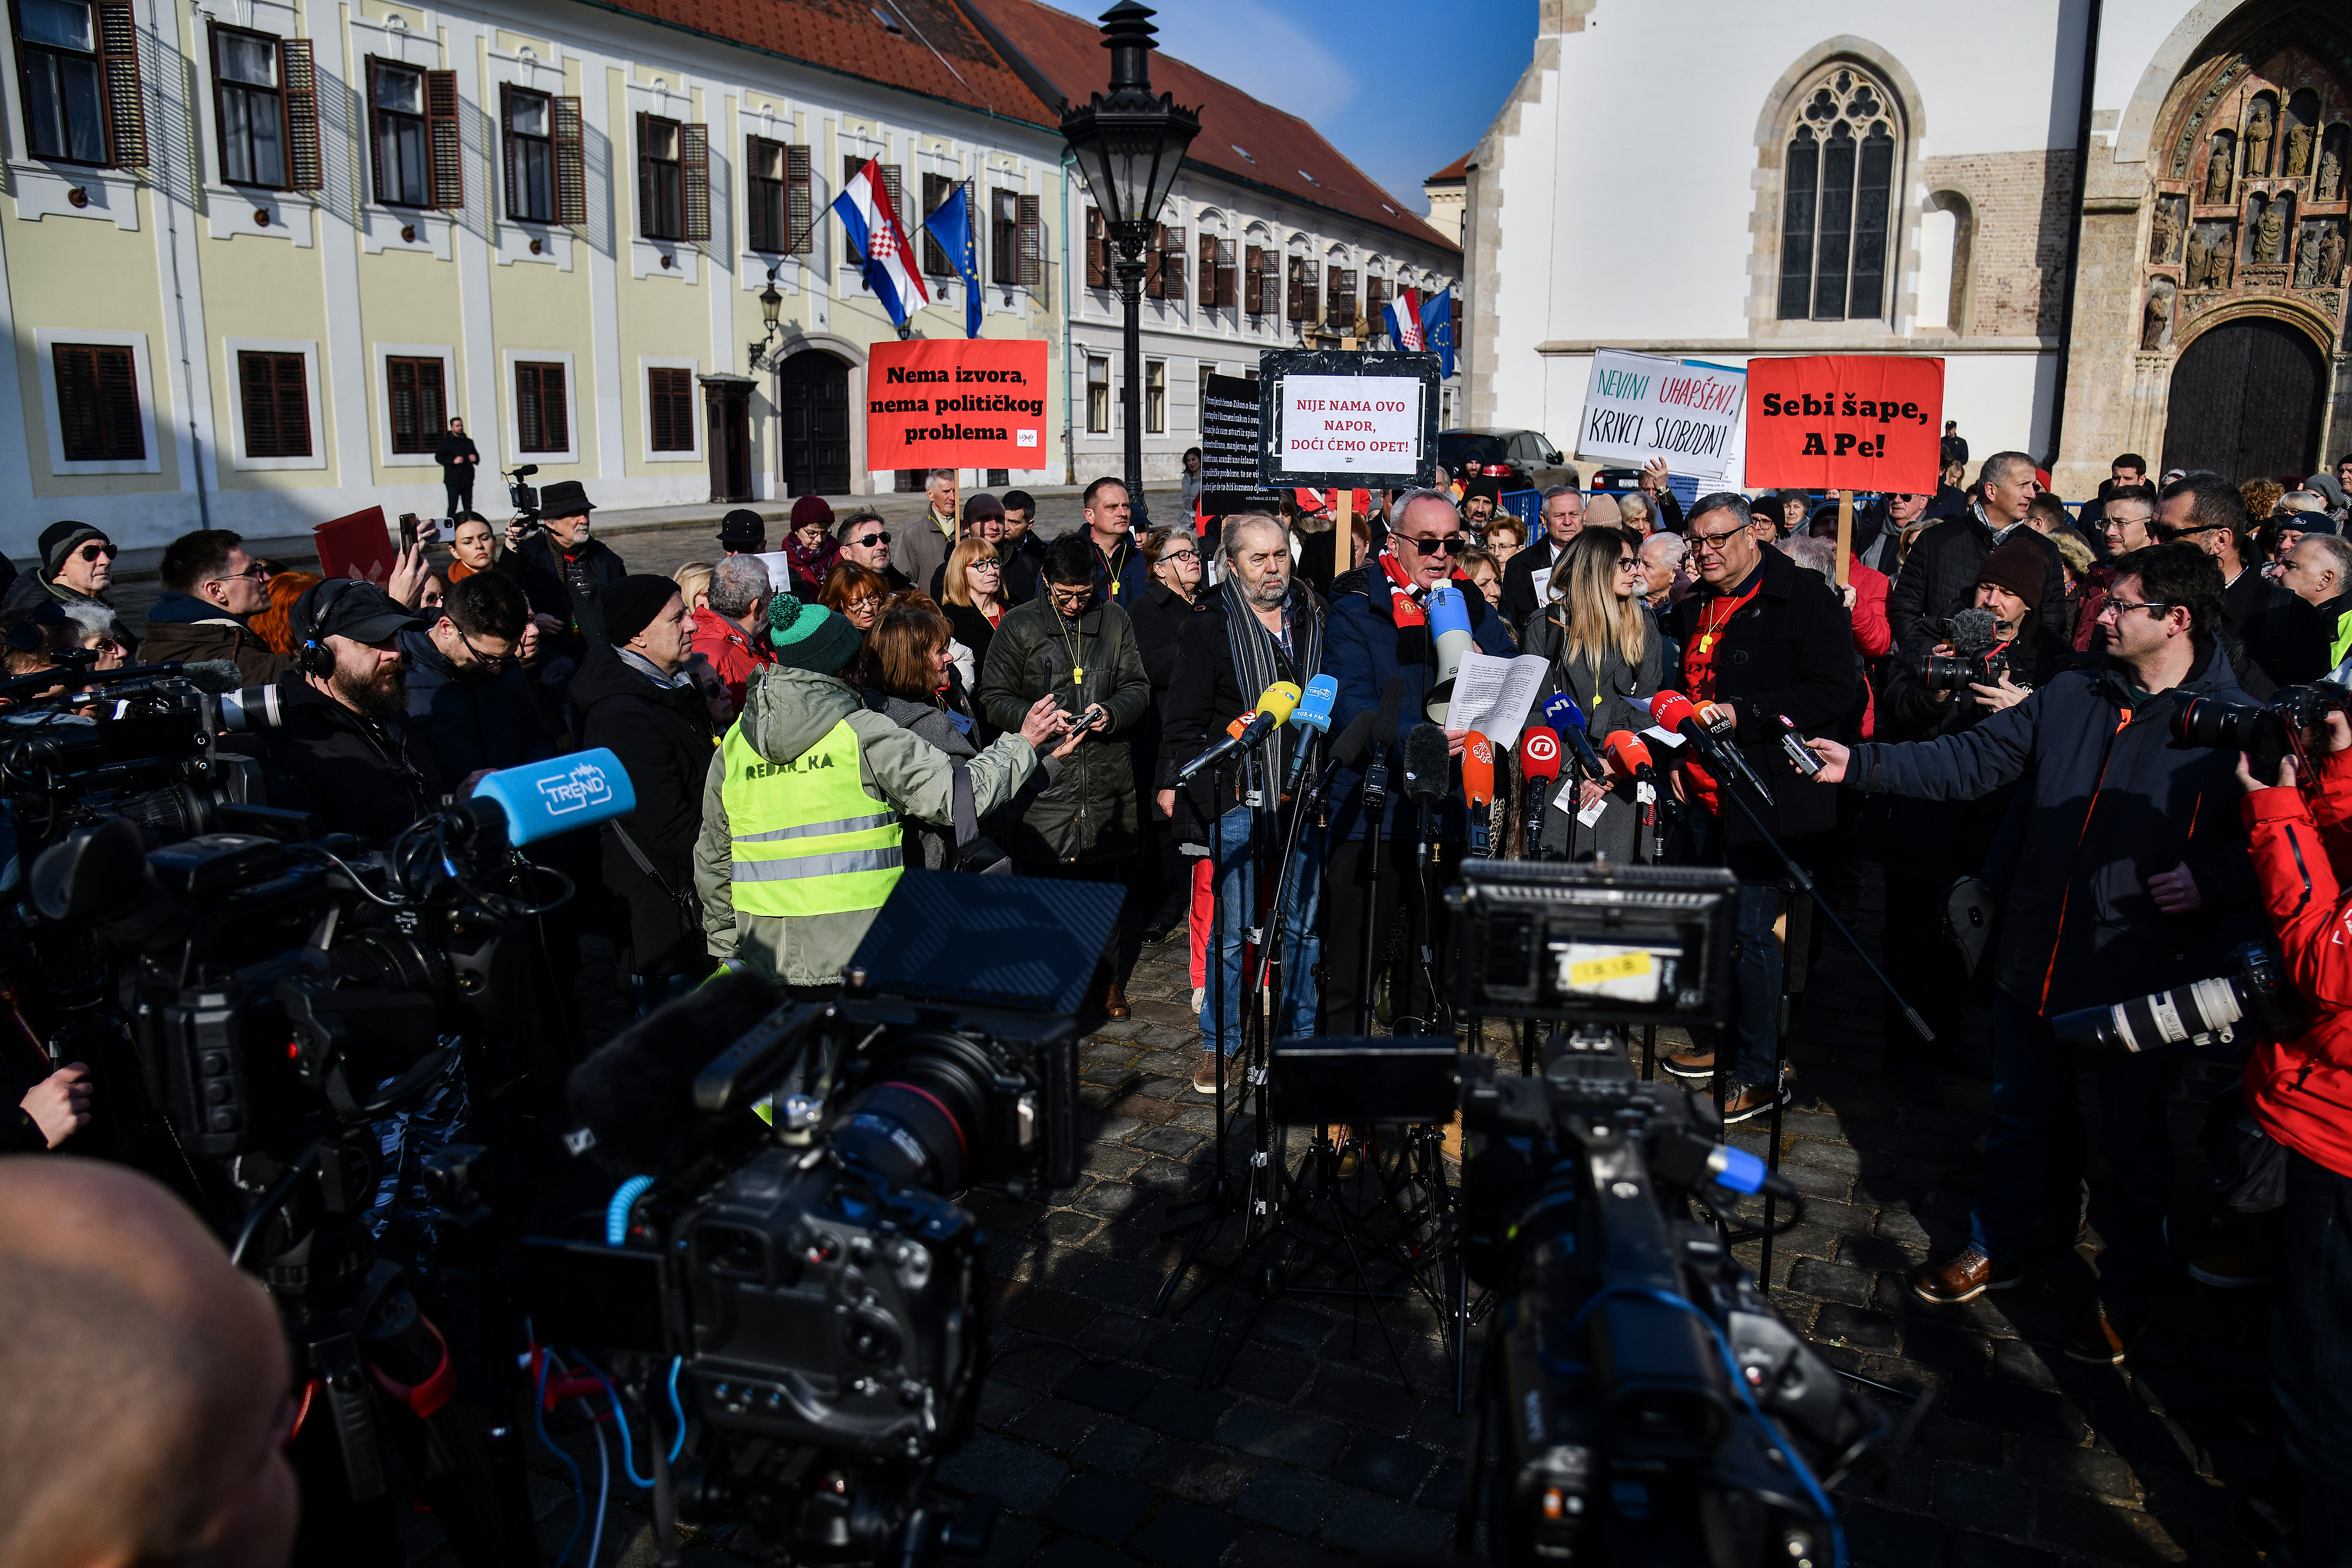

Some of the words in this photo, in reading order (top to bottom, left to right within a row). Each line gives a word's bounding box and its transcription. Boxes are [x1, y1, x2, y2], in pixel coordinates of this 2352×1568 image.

[886, 366, 949, 384] Nema
[956, 365, 1027, 386] izvora,
[1598, 367, 1650, 401] NEVINI
[1660, 376, 1734, 416] UHAPŠENI,
[870, 396, 929, 413] nema
[935, 394, 1043, 416] političkog
[1233, 400, 1245, 409] Zakon
[1297, 400, 1325, 412] NIJE
[1329, 400, 1372, 412] NAMA
[1375, 401, 1405, 412] OVO
[1763, 392, 1835, 417] Sebi
[1842, 392, 1929, 425] šape,
[904, 423, 1007, 445] problema
[1228, 428, 1241, 436] stvari
[1241, 428, 1245, 436] iz
[1245, 429, 1258, 439] spisa
[1324, 420, 1376, 433] NAPOR,
[1589, 407, 1643, 444] KRIVCI
[1649, 416, 1728, 459] SLOBODNI
[1291, 436, 1324, 450] DOĆI
[1328, 437, 1366, 451] ĆEMO
[1369, 441, 1408, 453] OPET!
[1240, 456, 1254, 464] izlaze
[1234, 483, 1254, 492] kazneno
[1266, 688, 1295, 701] RTL
[1309, 688, 1329, 698] TREND
[1545, 698, 1570, 718] N1
[1655, 704, 1668, 724] VIDA
[1232, 721, 1244, 732] SAT
[1710, 719, 1731, 733] mreža
[547, 774, 606, 804] TREND
